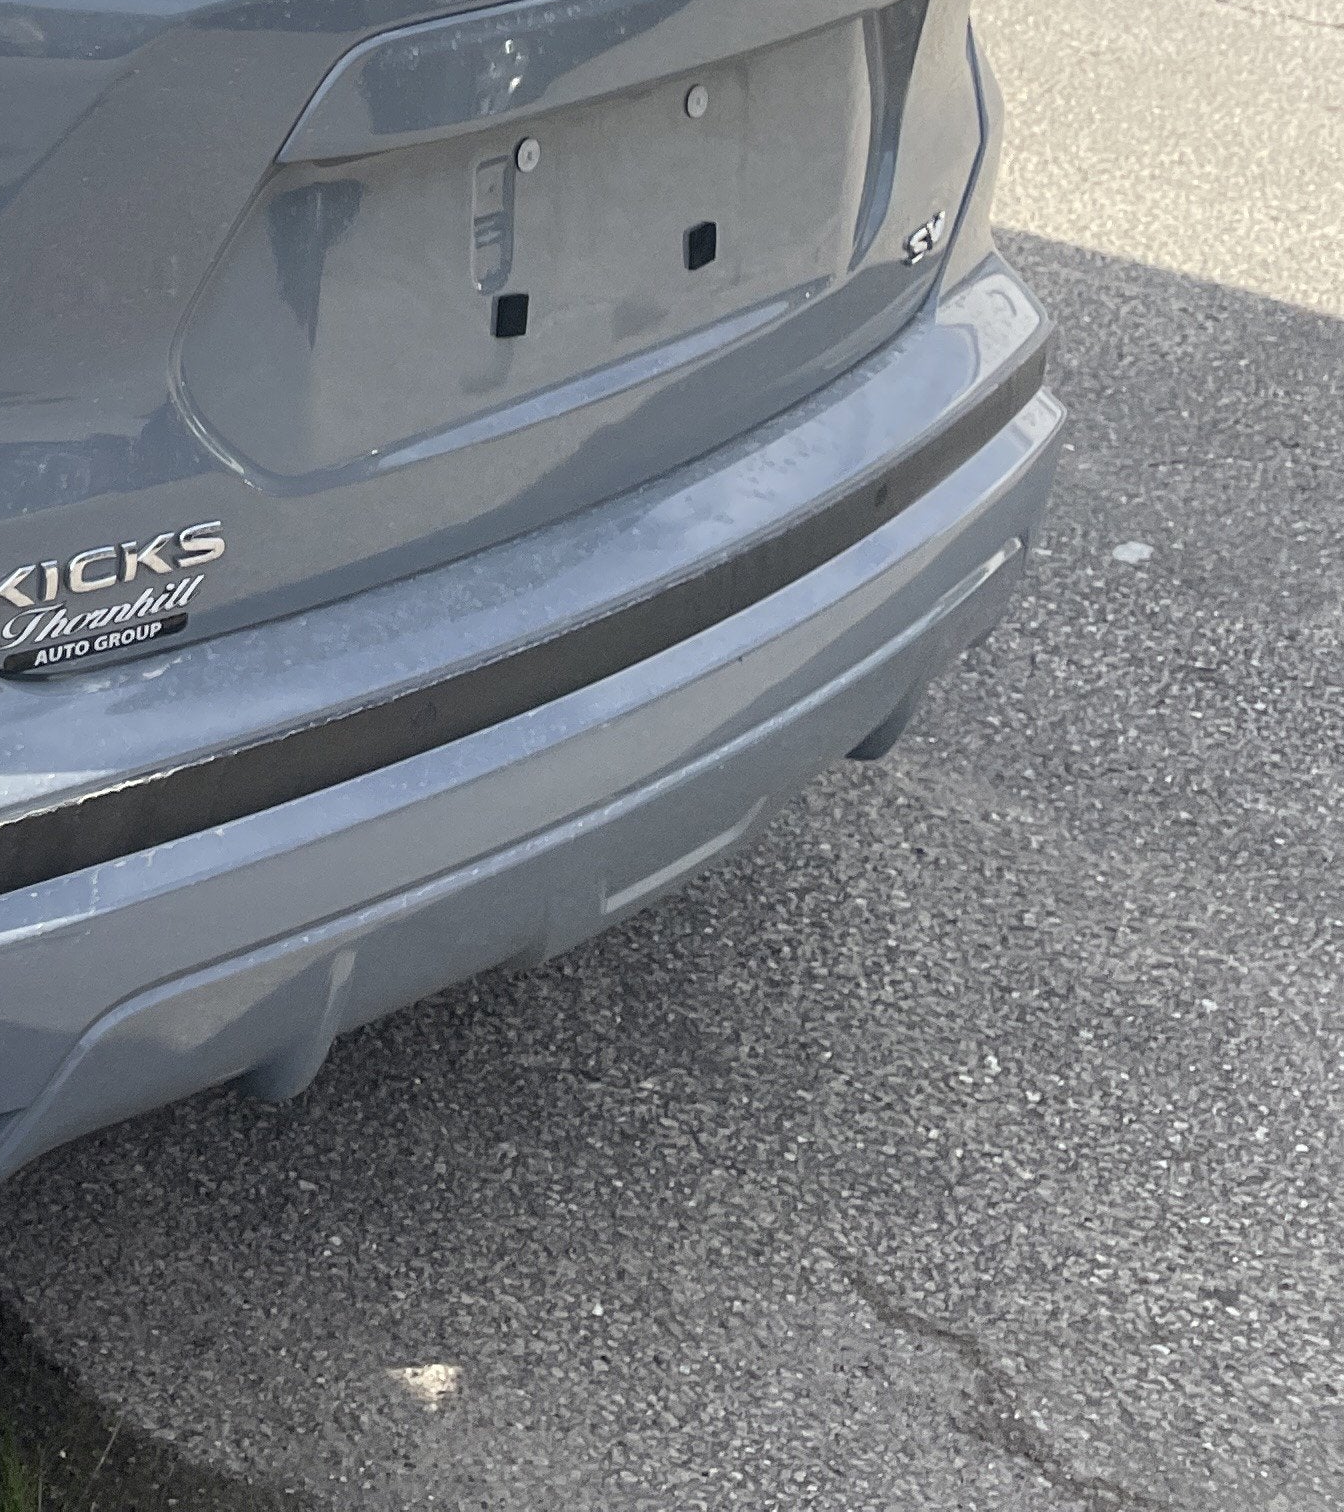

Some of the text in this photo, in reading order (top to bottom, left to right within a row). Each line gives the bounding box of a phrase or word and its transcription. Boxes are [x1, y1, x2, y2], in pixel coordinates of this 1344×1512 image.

[905, 210, 945, 265] SV
[33, 621, 162, 667] AUTO GROUP
